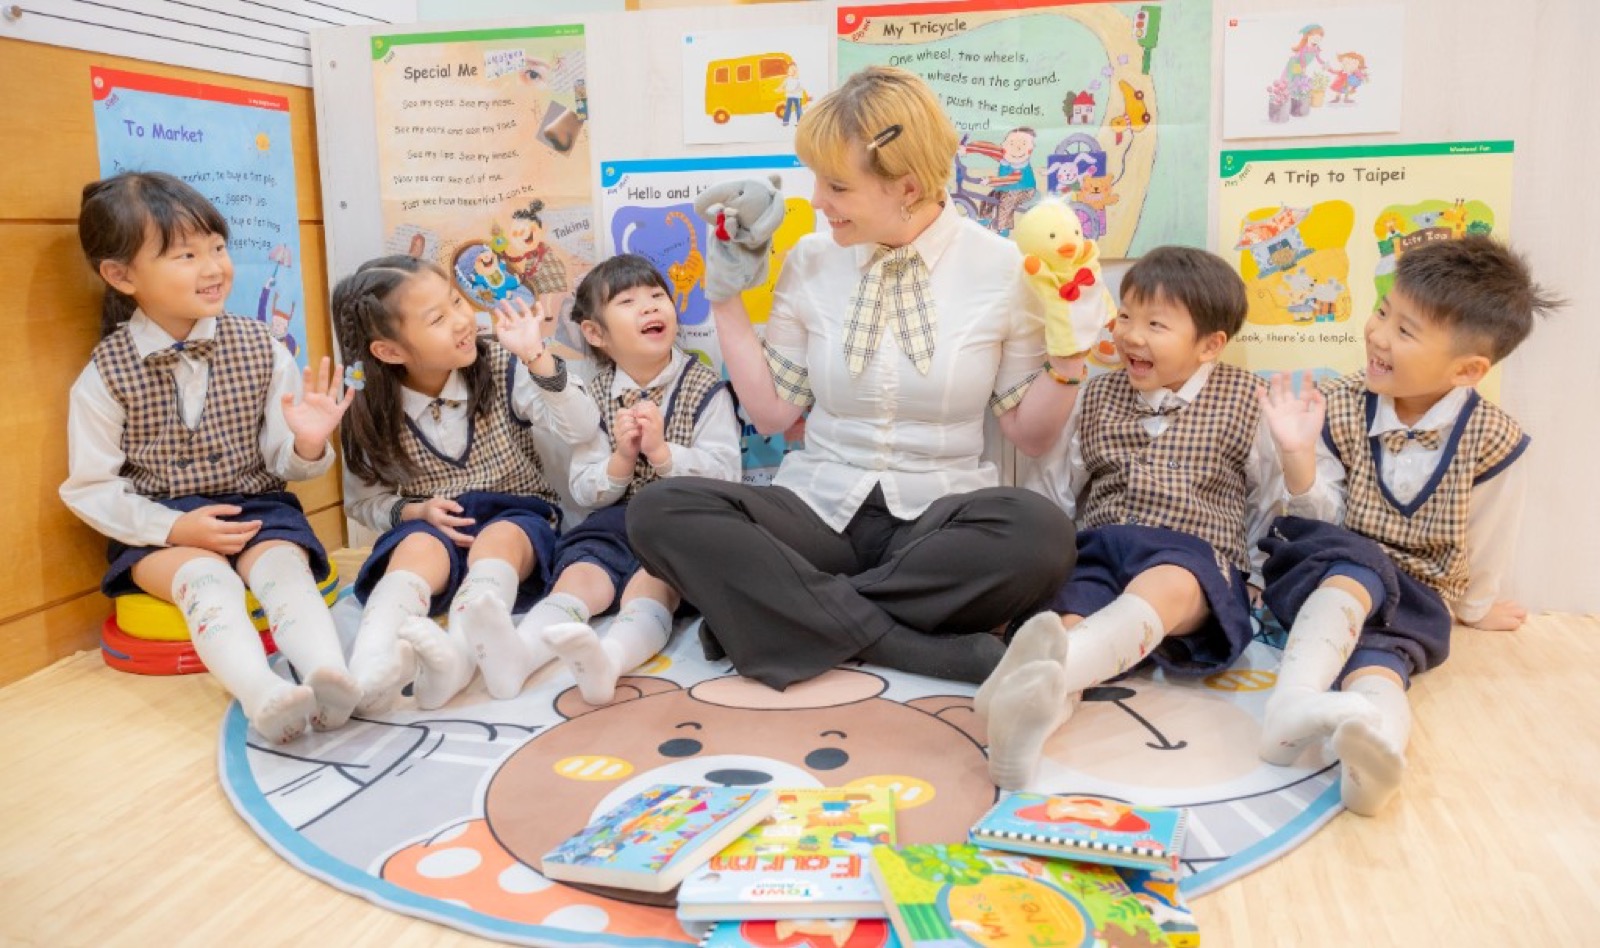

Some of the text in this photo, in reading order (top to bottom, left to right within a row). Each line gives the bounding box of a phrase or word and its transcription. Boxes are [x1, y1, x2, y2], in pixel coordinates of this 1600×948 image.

[883, 23, 904, 38] My
[909, 18, 967, 36] Tricycle
[889, 54, 913, 66] One
[958, 52, 980, 62] two
[404, 64, 451, 82] Special
[457, 63, 479, 77] Me
[927, 70, 1060, 91] wheels on the ground.
[947, 96, 973, 107] push
[977, 99, 998, 112] the
[124, 119, 203, 142] To Market
[1264, 172, 1275, 184] A
[1284, 170, 1320, 187] Trip
[1327, 170, 1345, 182] to
[1353, 167, 1406, 185] Taipei
[628, 184, 661, 200] Hello
[667, 185, 690, 199] and
[552, 219, 590, 239] Taking
[1425, 231, 1448, 240] Zoo
[1320, 332, 1357, 345] temple.
[709, 854, 861, 879] Farm
